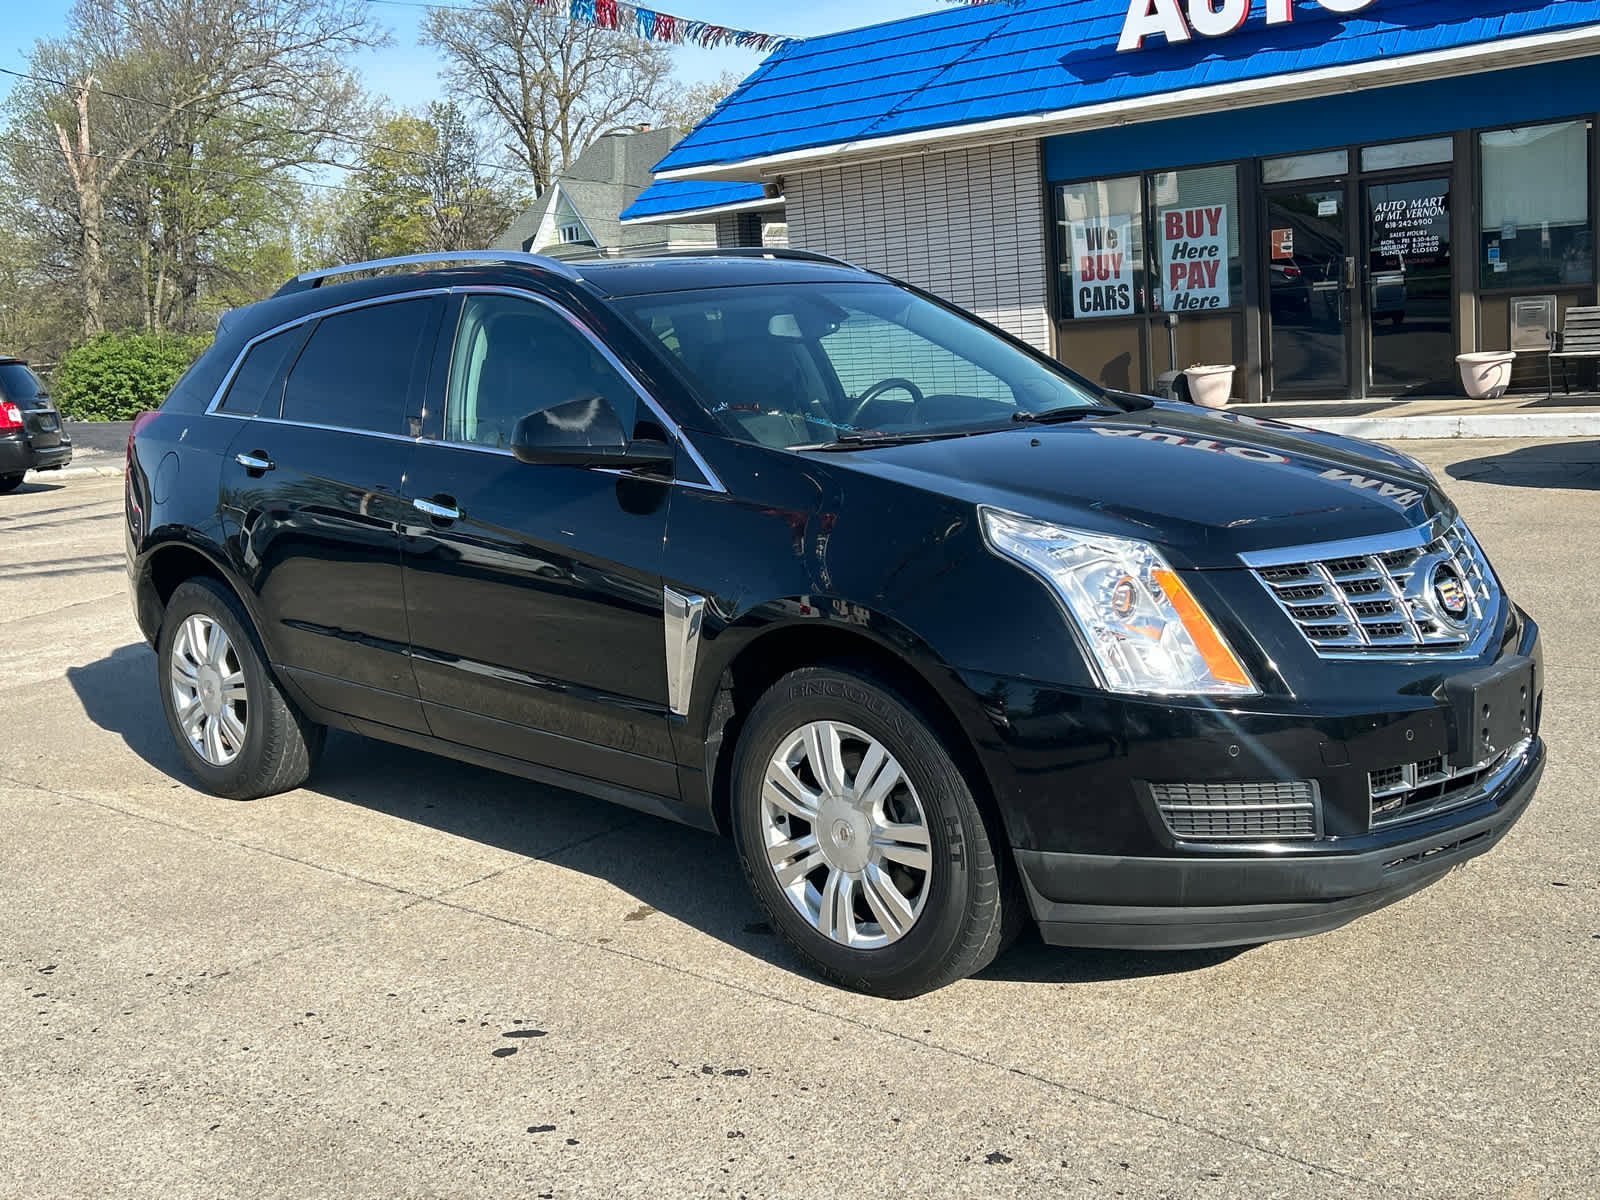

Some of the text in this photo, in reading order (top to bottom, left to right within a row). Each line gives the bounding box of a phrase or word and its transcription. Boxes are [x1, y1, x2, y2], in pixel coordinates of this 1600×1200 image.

[1374, 197, 1446, 212] AUTO MART
[1374, 206, 1446, 221] of MT. VERNON
[1164, 207, 1222, 240] BUY
[1085, 227, 1118, 250] We
[1171, 241, 1219, 260] Here
[1080, 253, 1123, 282] BUY
[1169, 259, 1221, 291] PAY
[1079, 283, 1130, 312] CARS
[1173, 291, 1221, 310] Here
